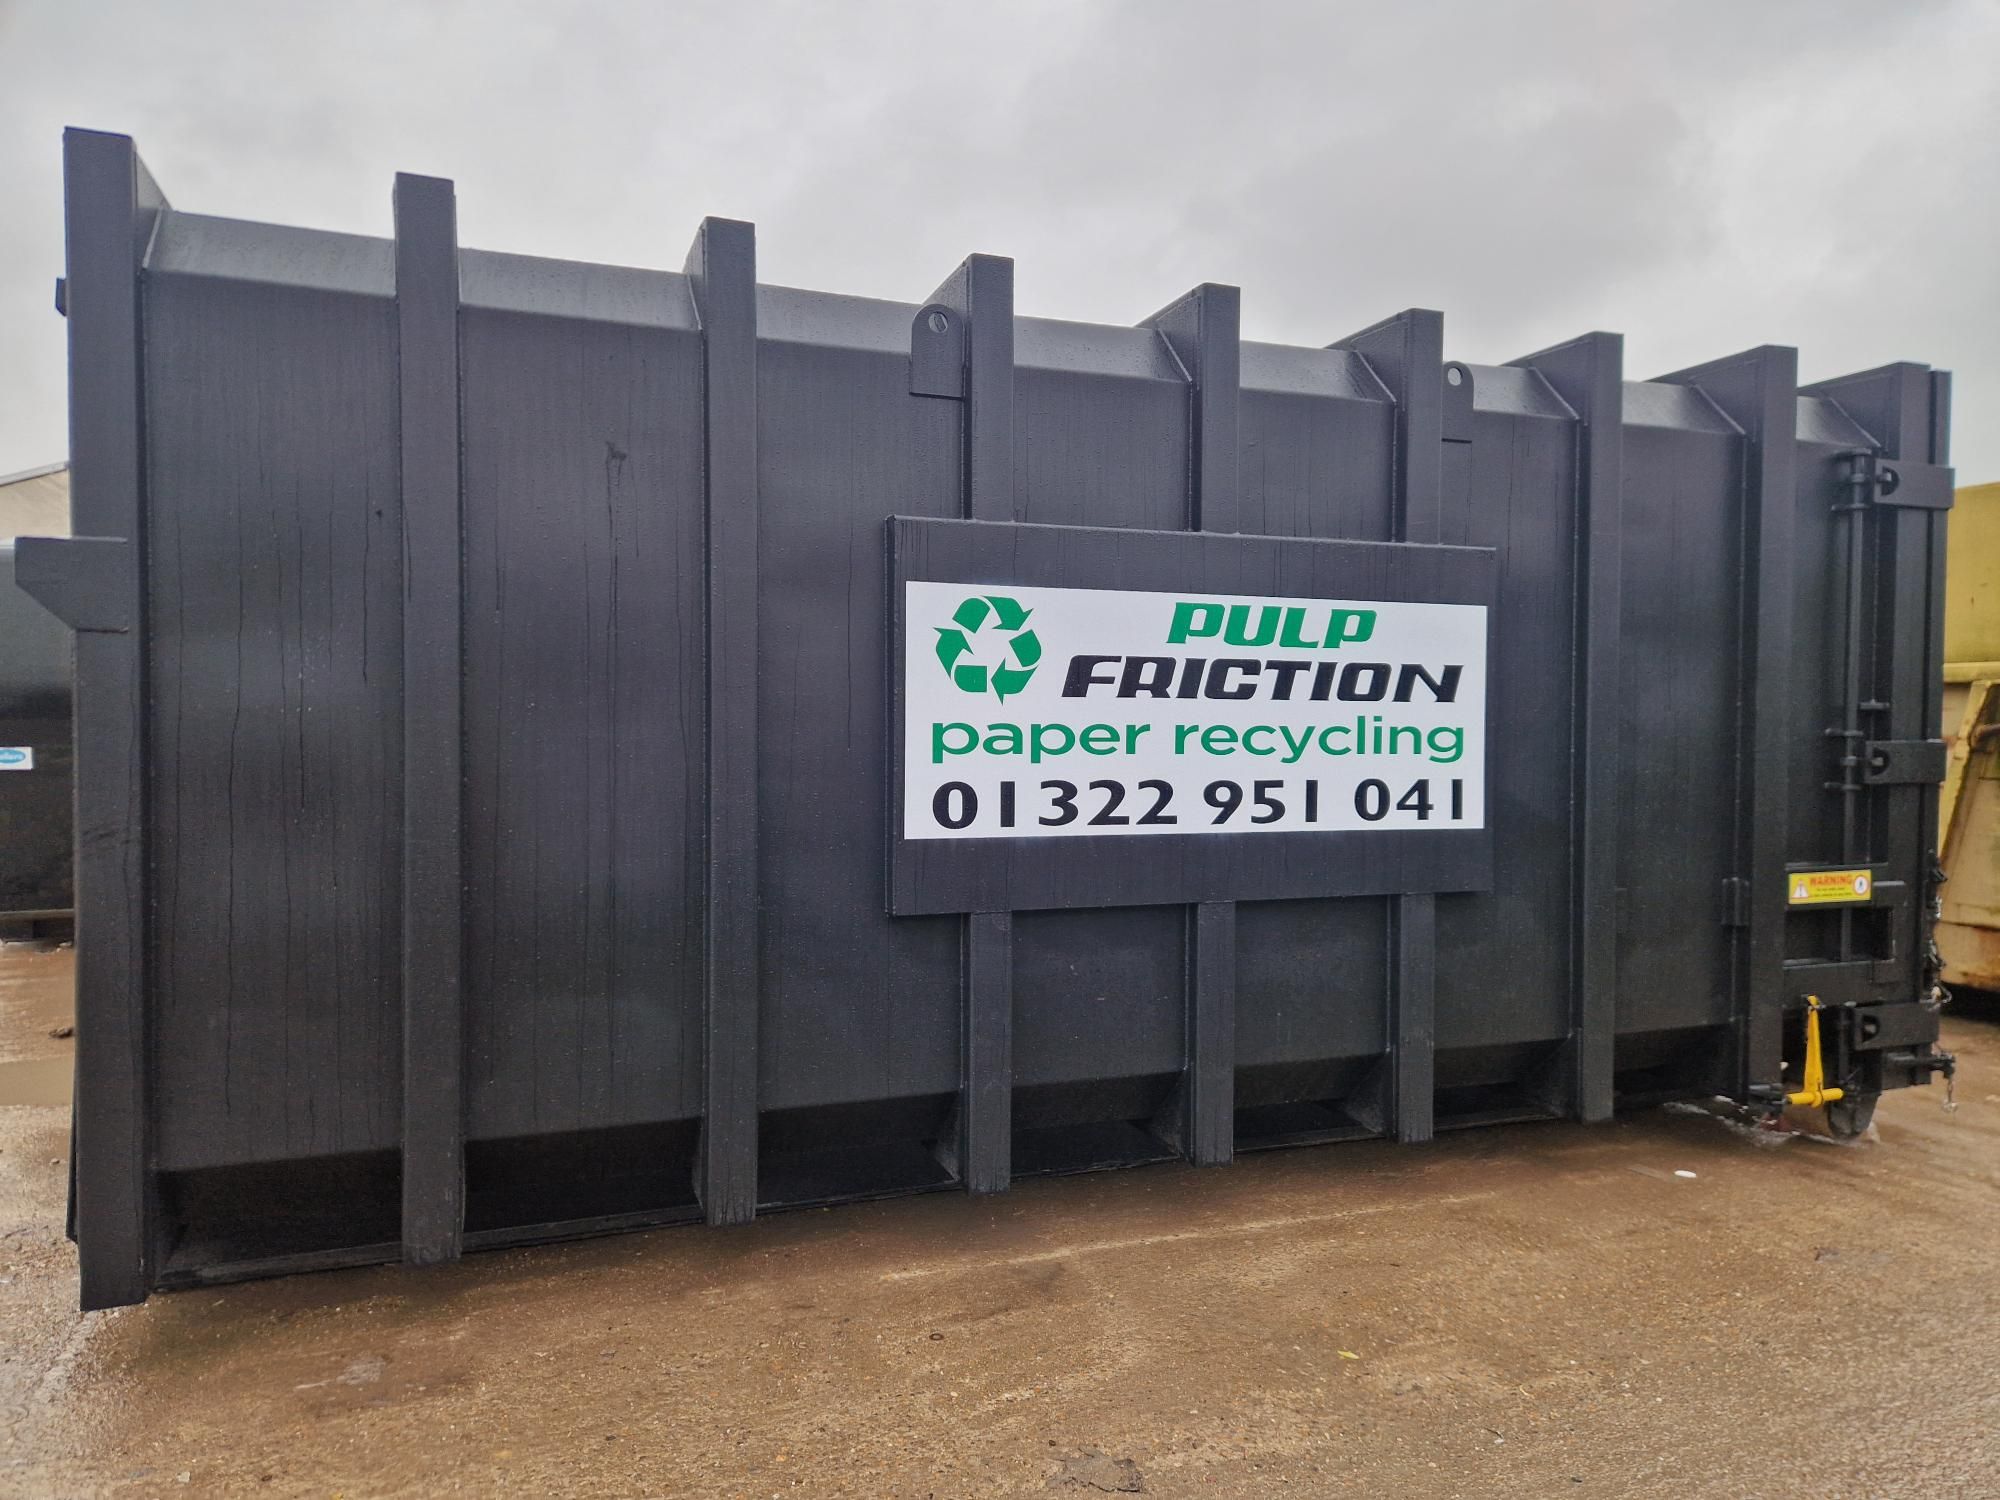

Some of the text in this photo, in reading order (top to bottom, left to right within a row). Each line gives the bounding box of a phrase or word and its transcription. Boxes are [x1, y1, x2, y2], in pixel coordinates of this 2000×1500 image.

[1165, 601, 1378, 649] PULP
[1061, 654, 1464, 703] FRICTION
[932, 715, 1464, 764] paper recycling
[932, 778, 1464, 830] 01322 951 041
[1809, 875, 1853, 887] WARNING
